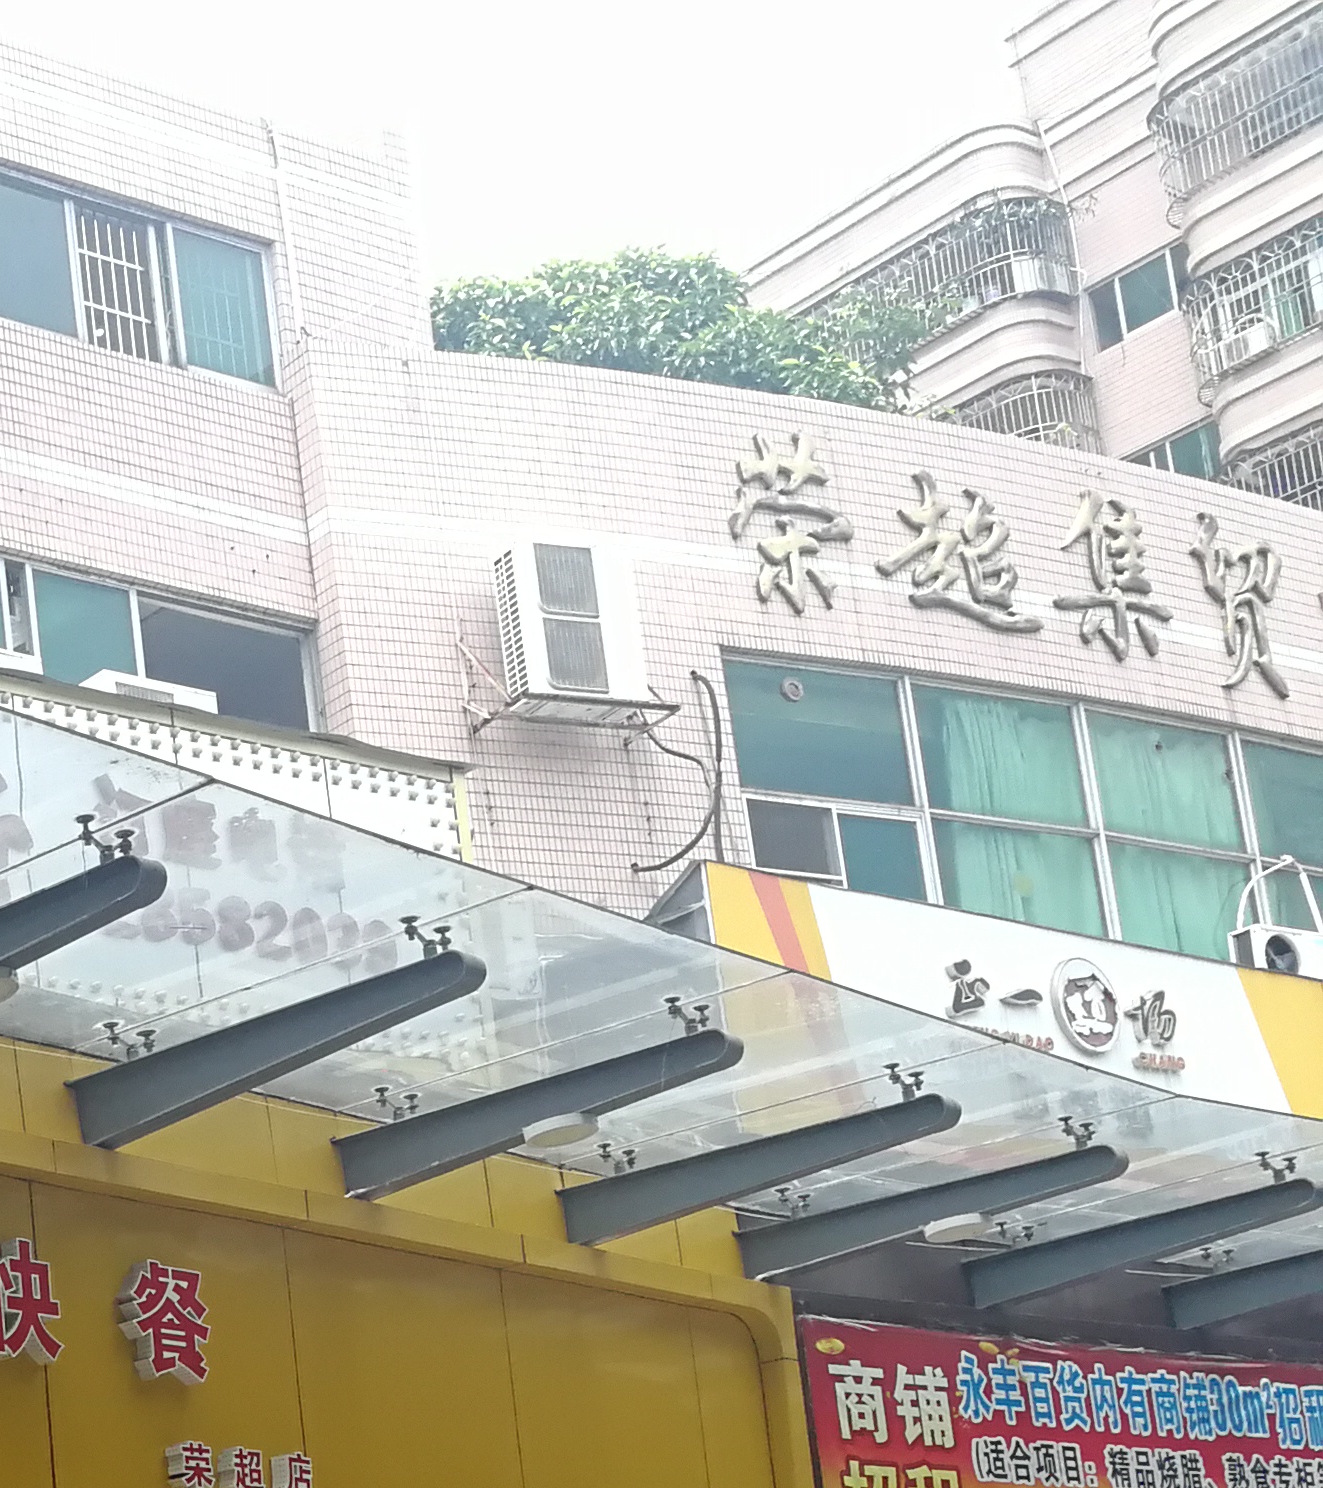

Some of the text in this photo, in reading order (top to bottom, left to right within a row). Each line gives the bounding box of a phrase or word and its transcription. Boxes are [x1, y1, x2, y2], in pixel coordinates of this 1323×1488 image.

[729, 430, 1323, 699] 荣超集贸
[827, 1358, 957, 1448] 商铺
